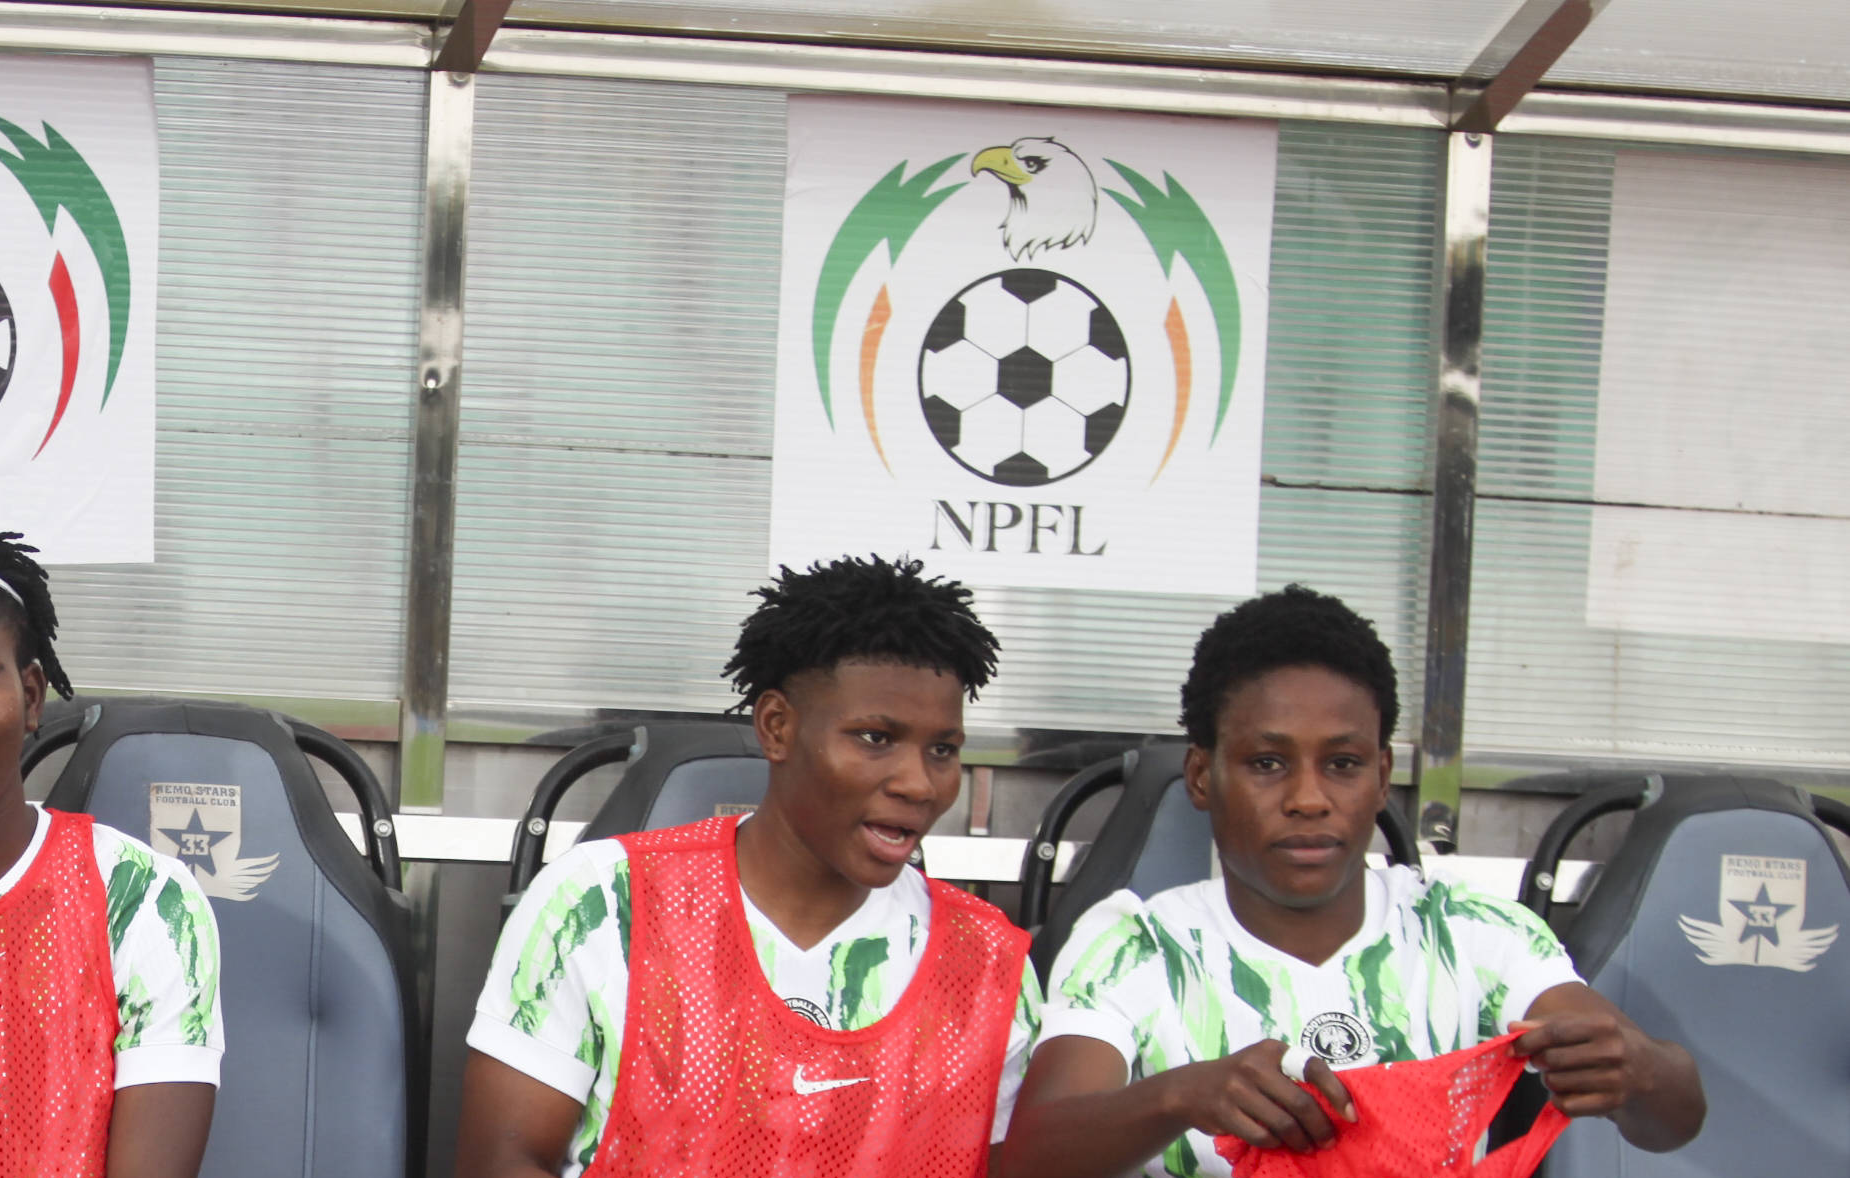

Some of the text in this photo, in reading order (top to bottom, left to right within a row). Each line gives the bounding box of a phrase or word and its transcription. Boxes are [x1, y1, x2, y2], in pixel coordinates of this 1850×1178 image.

[930, 499, 1108, 556] NPFL
[155, 796, 237, 807] FOOTBALL CLUB
[196, 786, 236, 798] STARS
[180, 833, 211, 856] 33
[1748, 904, 1777, 928] 33
